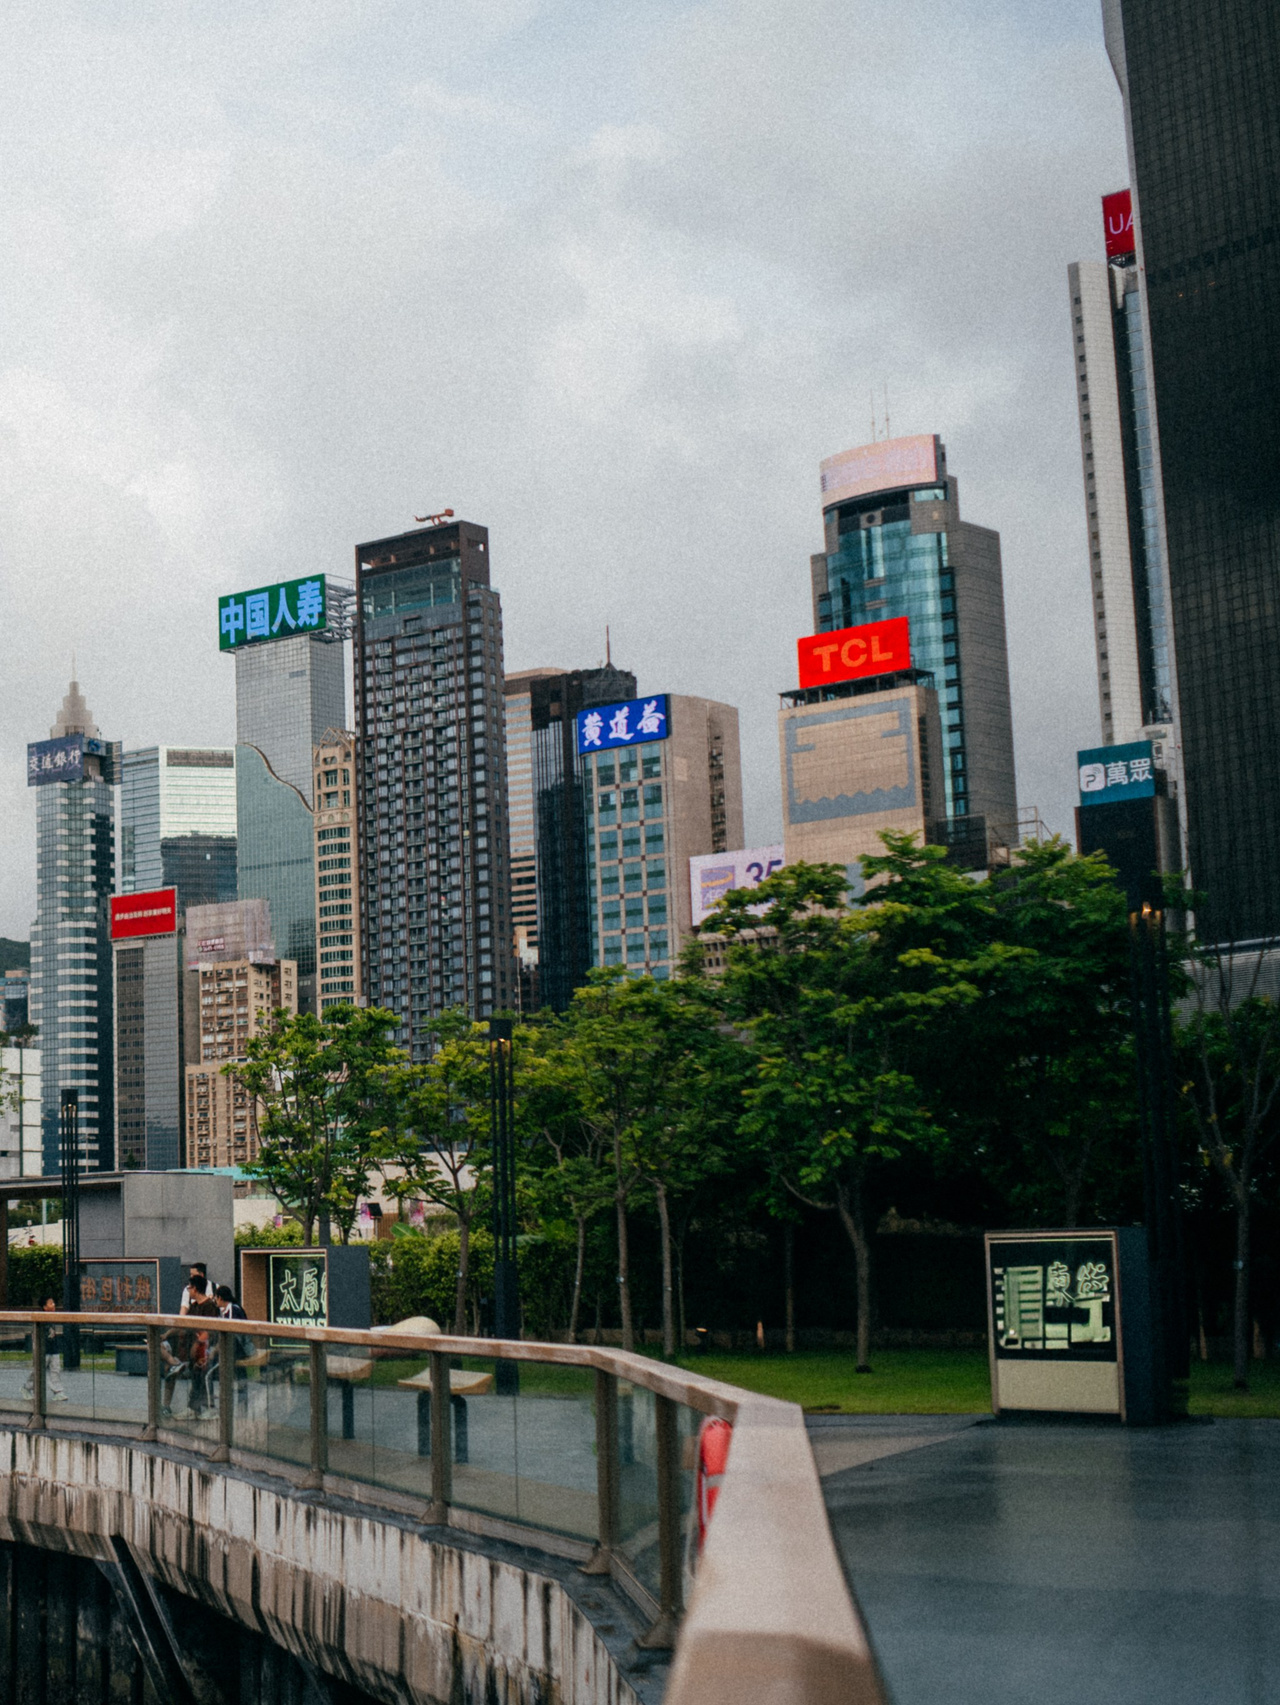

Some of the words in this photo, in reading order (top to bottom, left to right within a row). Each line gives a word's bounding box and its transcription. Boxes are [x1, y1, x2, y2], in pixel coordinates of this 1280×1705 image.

[221, 580, 322, 643] 中国人寿
[813, 636, 893, 672] TCL
